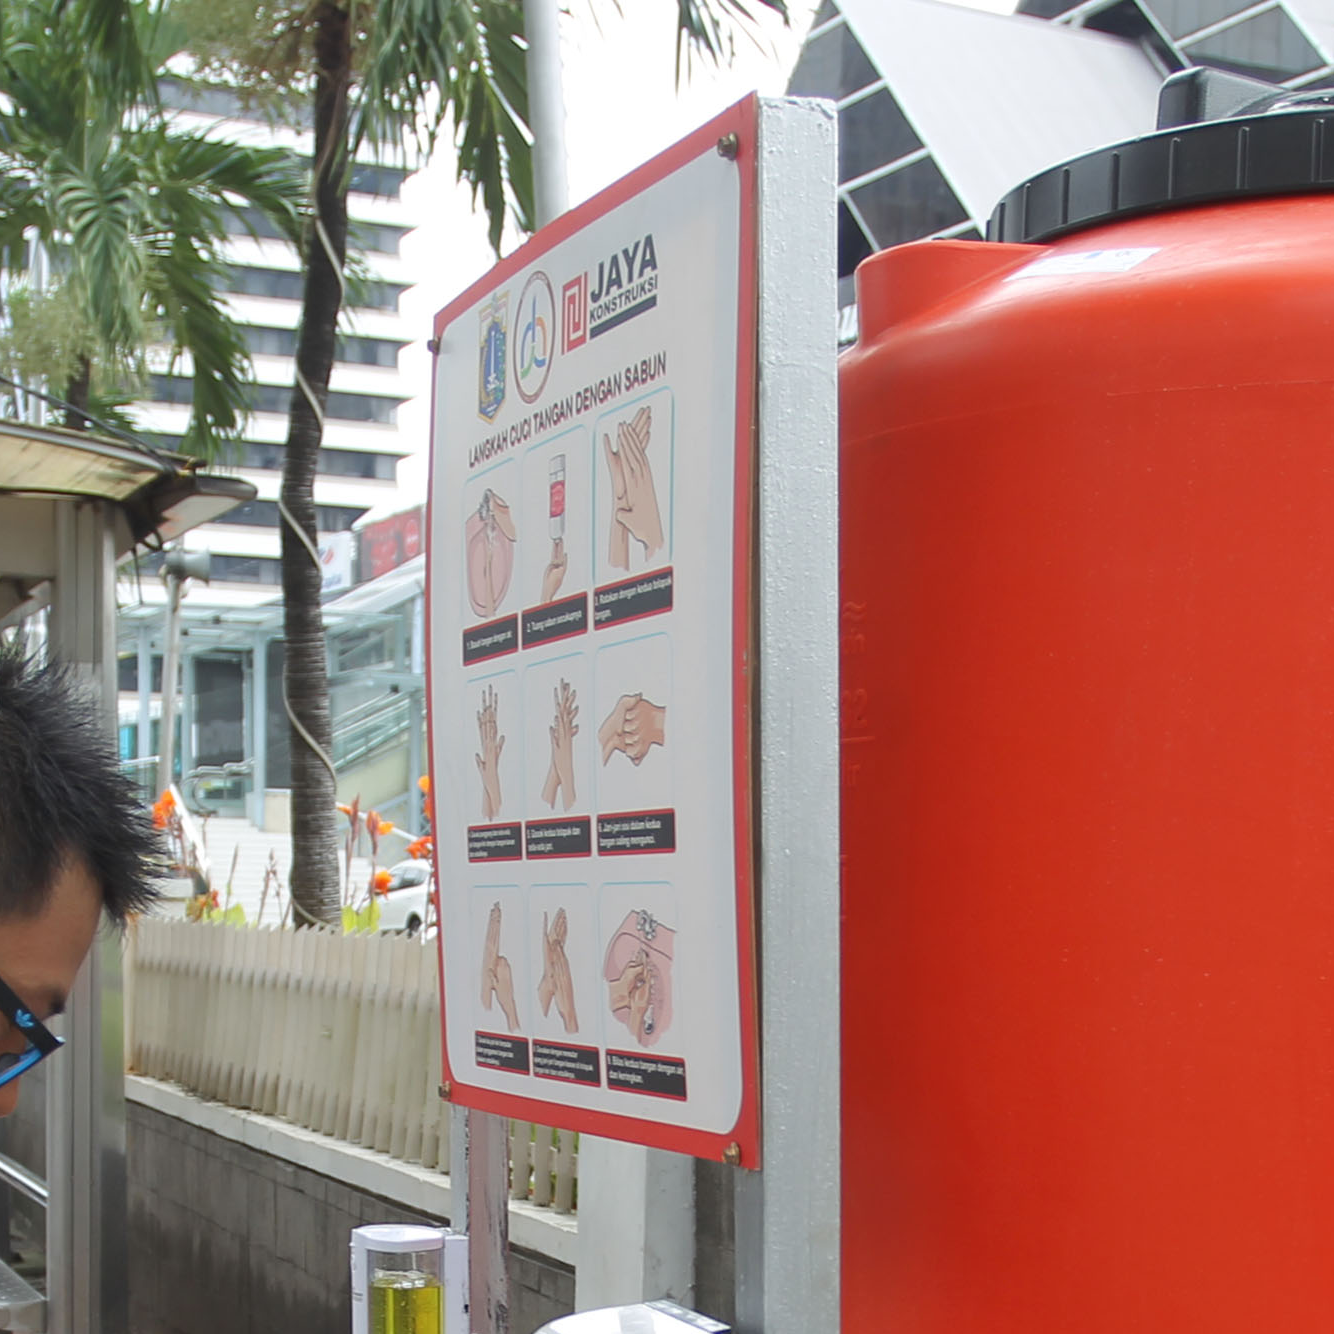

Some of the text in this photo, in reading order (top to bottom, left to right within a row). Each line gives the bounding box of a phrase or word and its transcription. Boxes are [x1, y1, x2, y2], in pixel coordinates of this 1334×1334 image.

[589, 274, 659, 323] KONSTRUKSI
[590, 233, 658, 303] JAYA
[469, 350, 667, 468] LANGKAH CUCI TANGAN DENGAN SABUN
